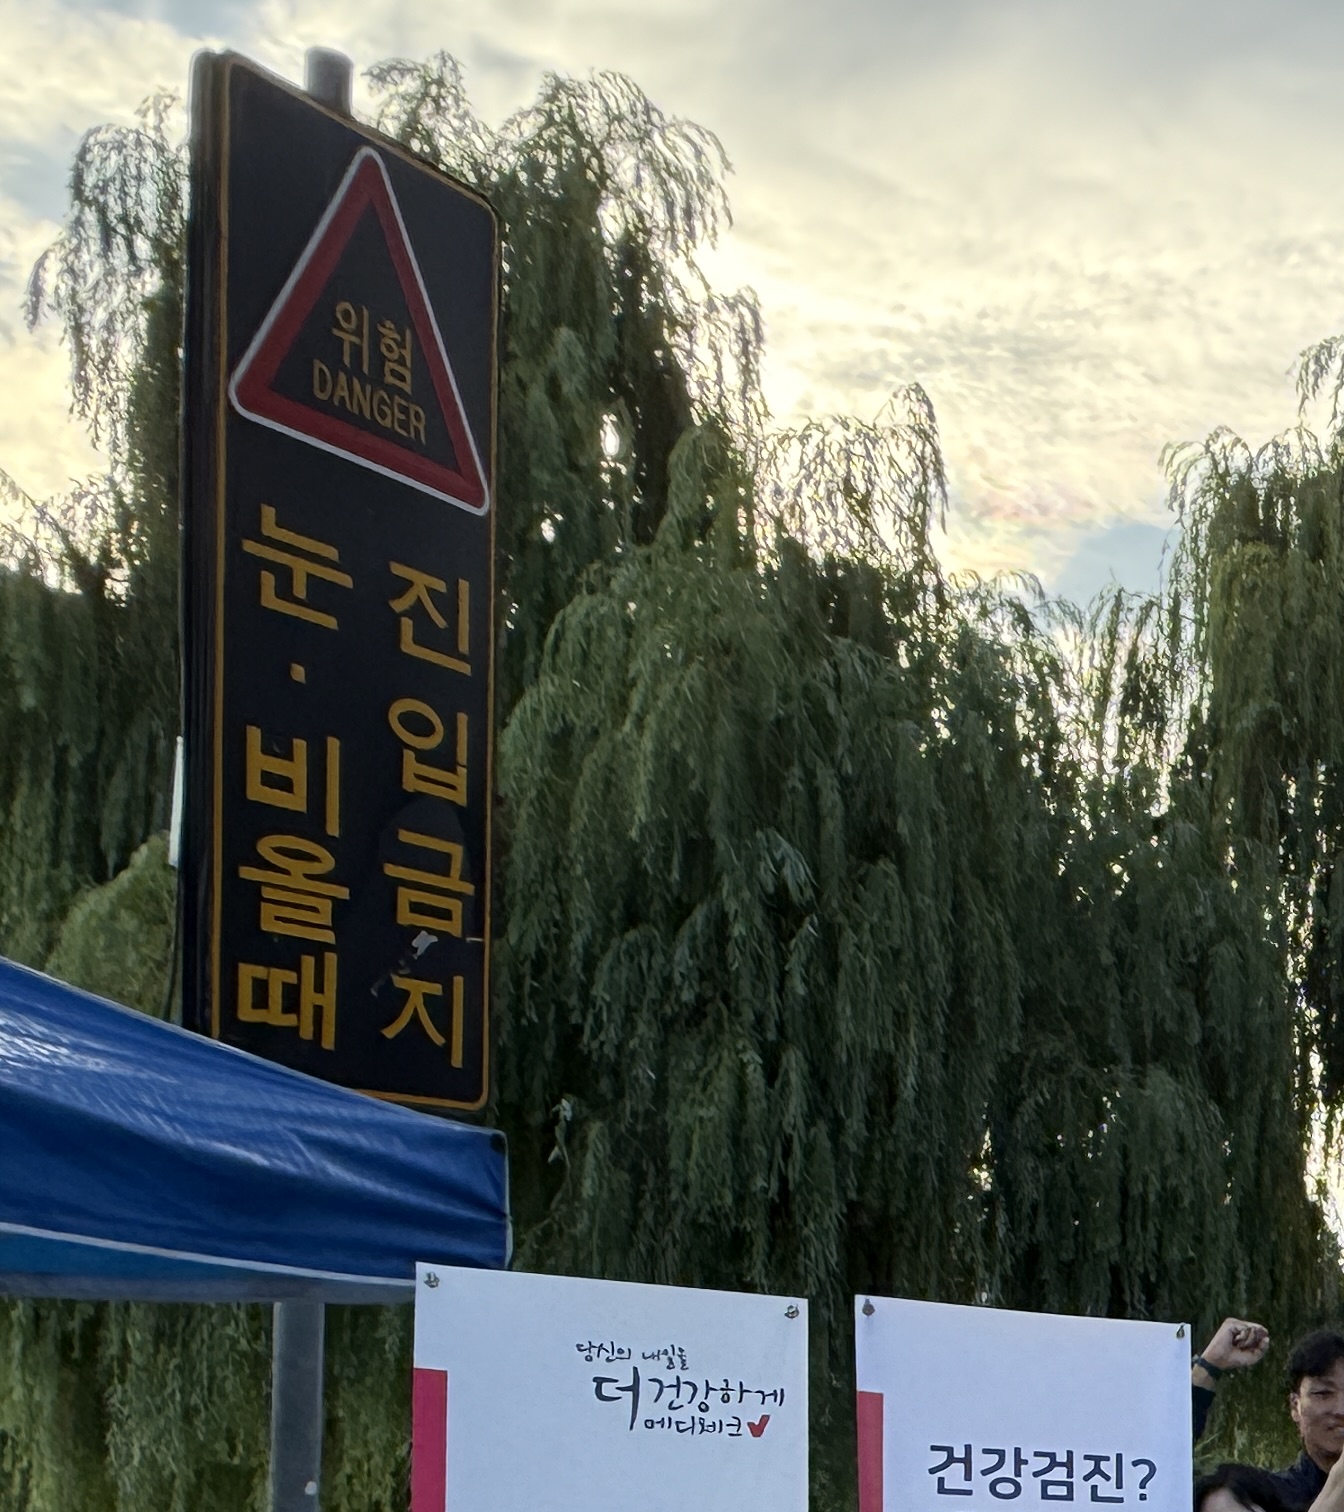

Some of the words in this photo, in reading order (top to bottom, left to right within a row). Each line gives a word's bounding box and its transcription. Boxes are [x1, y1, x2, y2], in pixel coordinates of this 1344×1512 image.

[332, 301, 412, 395] 위험
[313, 358, 427, 445] DANGER
[382, 560, 475, 1068] 진입금지
[576, 1341, 632, 1363] 당신의
[642, 1344, 690, 1371] 내일을
[644, 1415, 742, 1437] 메디체크
[927, 1443, 1158, 1504] 건강검진?
